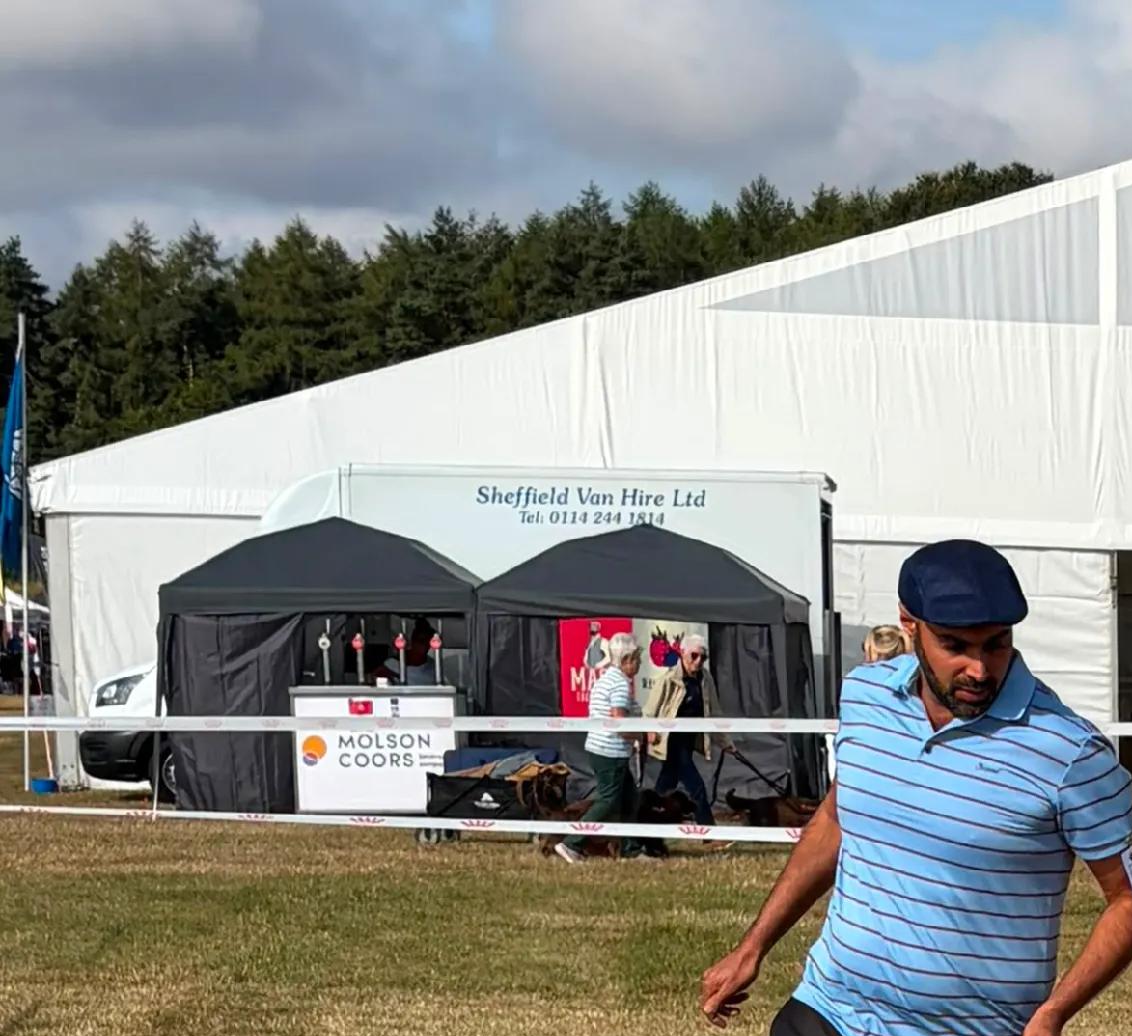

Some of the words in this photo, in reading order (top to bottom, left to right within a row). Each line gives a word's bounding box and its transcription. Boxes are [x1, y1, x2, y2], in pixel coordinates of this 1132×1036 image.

[476, 486, 569, 509] Sheffield
[577, 487, 614, 506] Van
[620, 488, 665, 507] Hire
[672, 488, 706, 508] Ltd
[549, 511, 588, 525] 0114
[593, 511, 622, 525] 244
[628, 511, 665, 526] 1814
[338, 733, 431, 749] MOLSON
[339, 752, 414, 768] COORS
